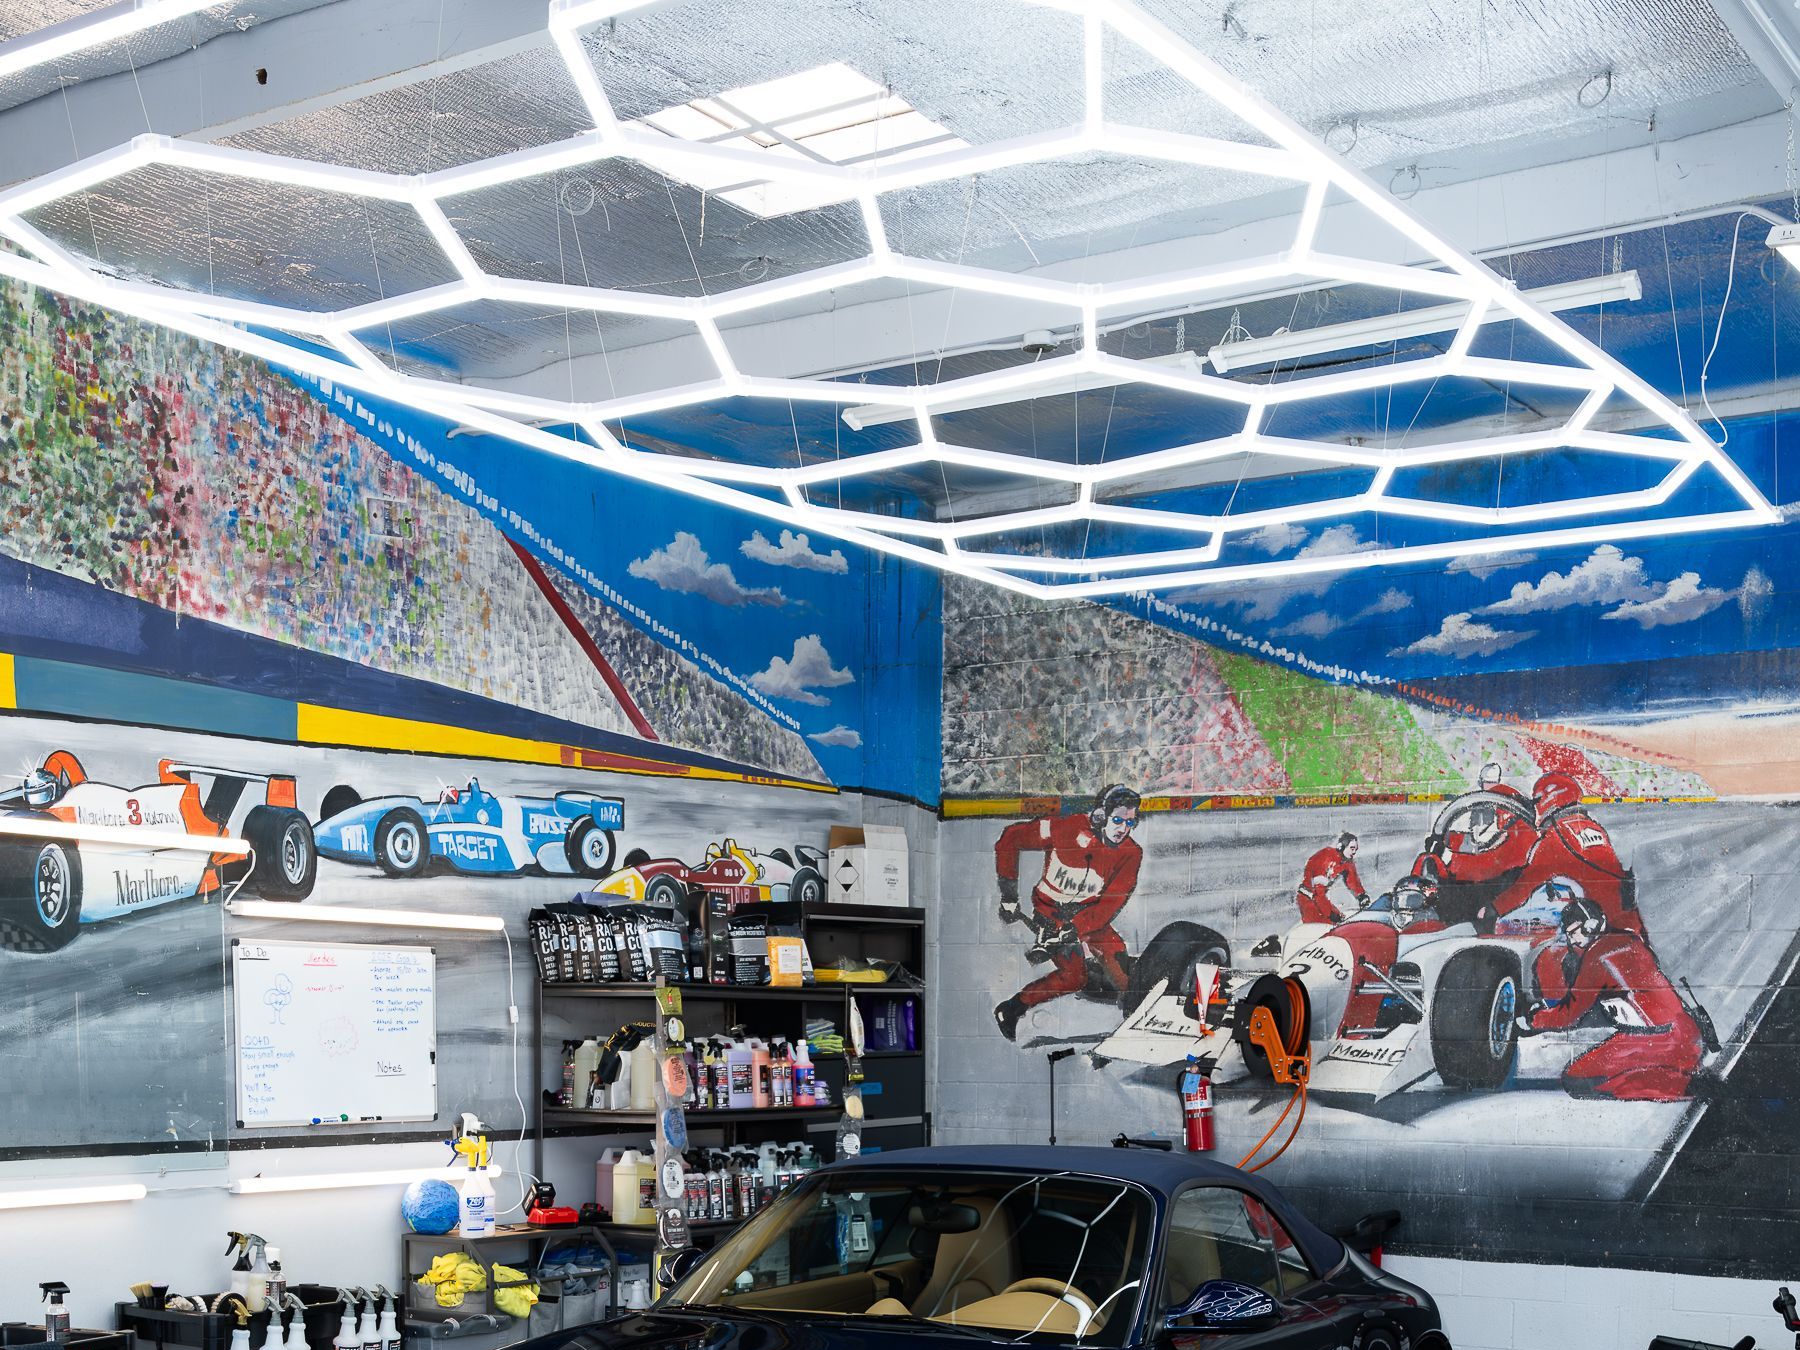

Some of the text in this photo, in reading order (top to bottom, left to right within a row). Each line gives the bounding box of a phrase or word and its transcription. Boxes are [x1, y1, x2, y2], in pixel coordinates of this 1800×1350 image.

[126, 799, 142, 825] 3
[438, 833, 498, 861] TARGET
[113, 868, 181, 906] Marlboro
[241, 947, 267, 957] To Do
[376, 1060, 403, 1074] Notes
